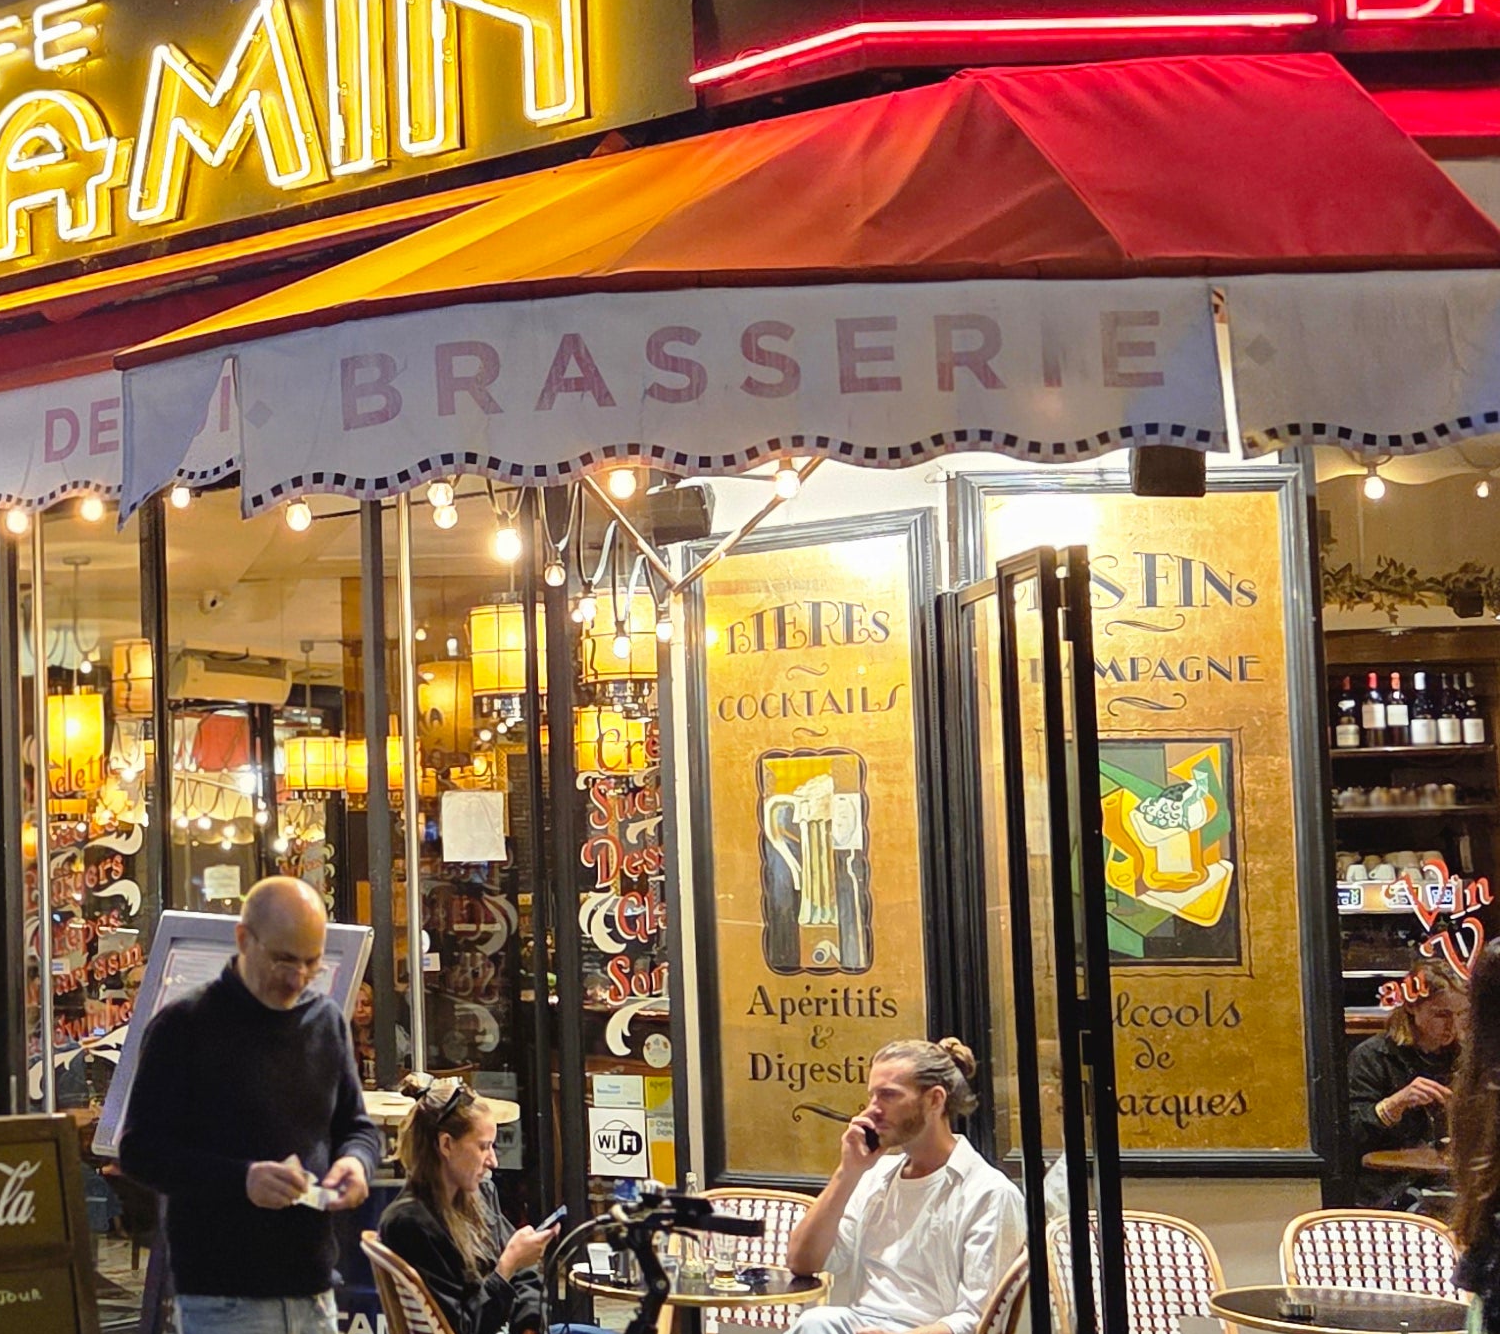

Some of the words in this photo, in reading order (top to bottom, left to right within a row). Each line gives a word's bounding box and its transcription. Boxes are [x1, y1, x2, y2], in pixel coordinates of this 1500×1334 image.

[340, 309, 1165, 431] BRASSERIE
[1094, 654, 1264, 683] MPAGNE
[718, 684, 906, 722] COCKTAILS
[1385, 859, 1495, 932] Vin
[746, 985, 899, 1025] Apéritifs
[1112, 988, 1243, 1028] lcools
[810, 1024, 835, 1050] &
[1134, 1037, 1176, 1069] de
[748, 1052, 871, 1093] Digesti
[1116, 1088, 1250, 1130] arques
